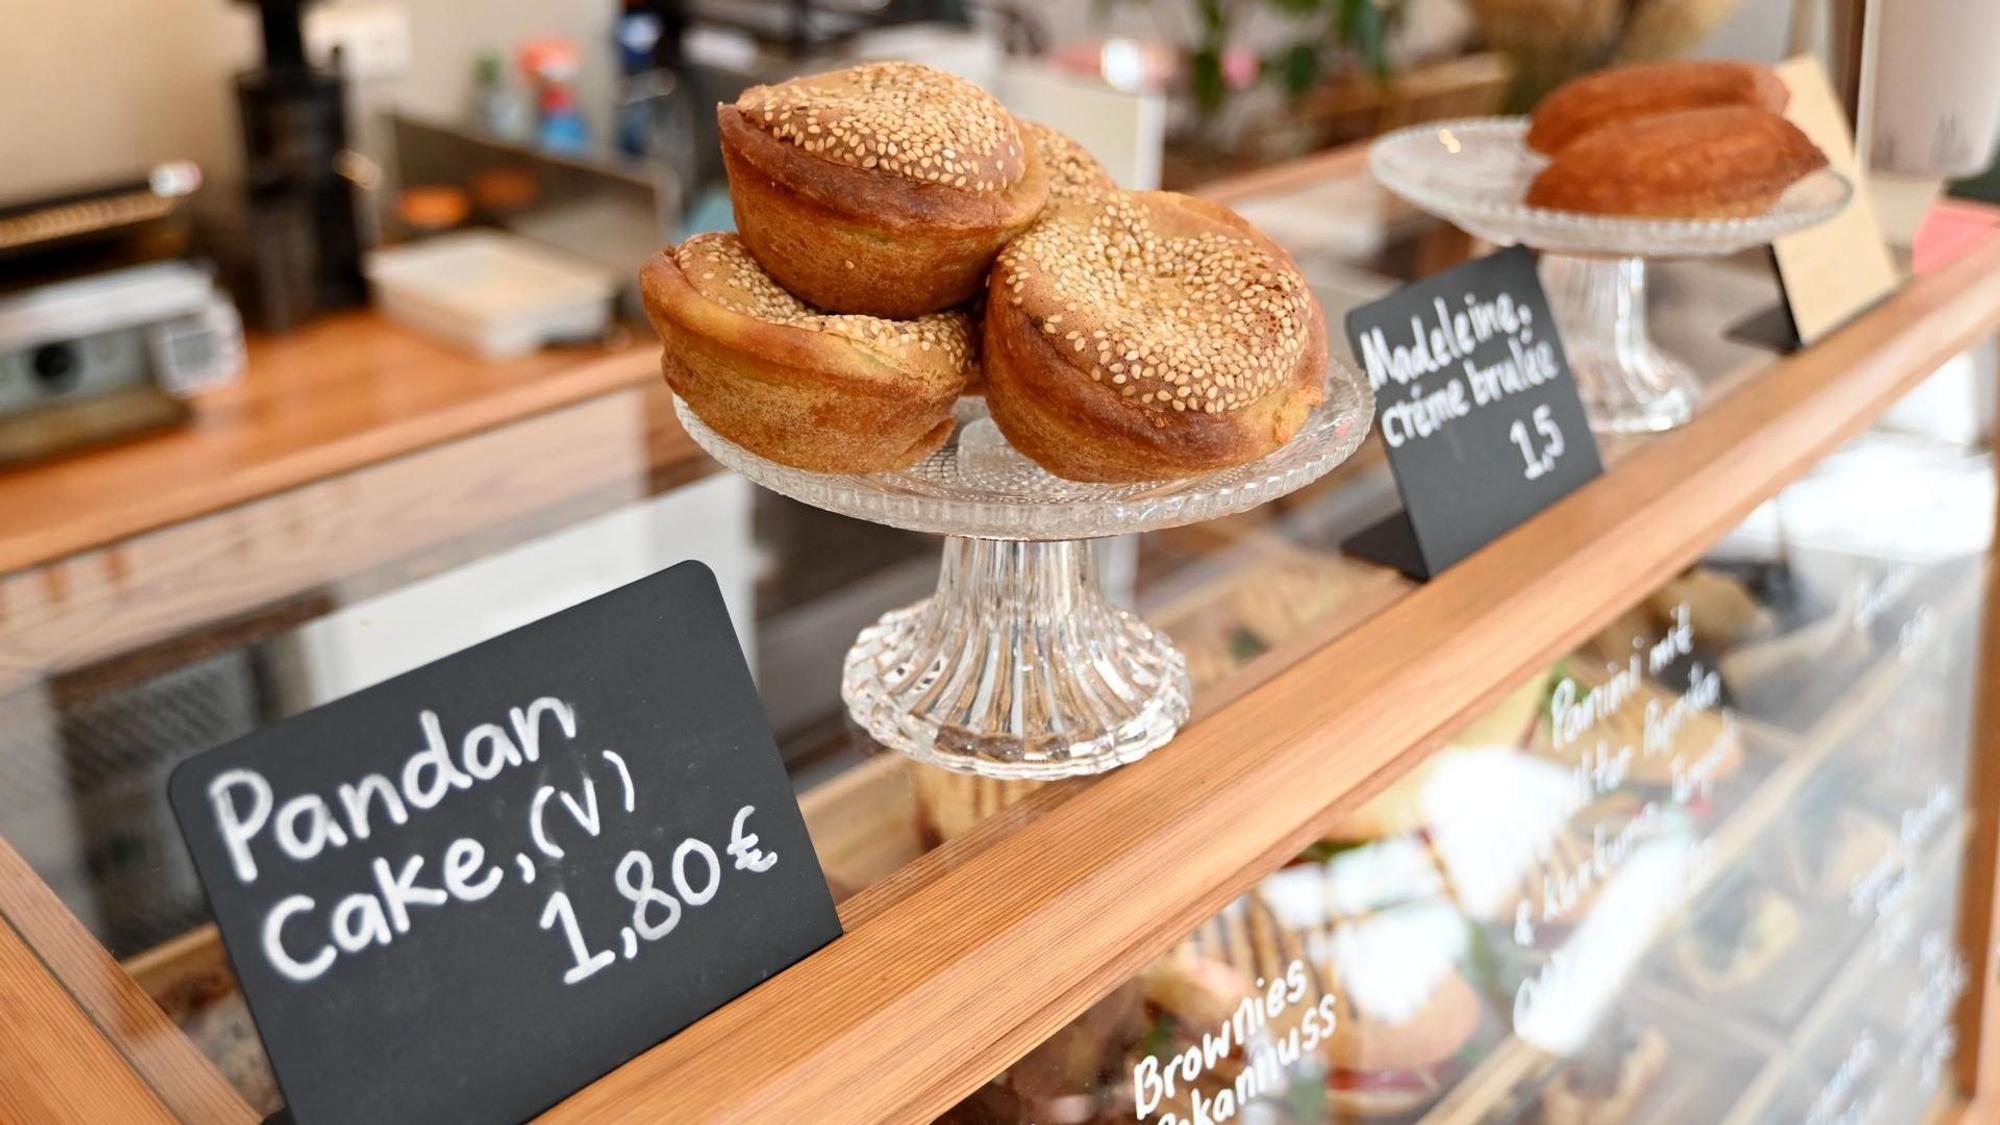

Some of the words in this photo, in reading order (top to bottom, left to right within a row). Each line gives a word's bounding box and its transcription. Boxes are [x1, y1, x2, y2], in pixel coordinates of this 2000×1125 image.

[1510, 403, 1565, 480] 1,5
[209, 696, 576, 883] Pandan
[539, 805, 778, 984] 1,80€
[1134, 959, 1308, 1120] Brownies
[1157, 993, 1337, 1125] kannuss
